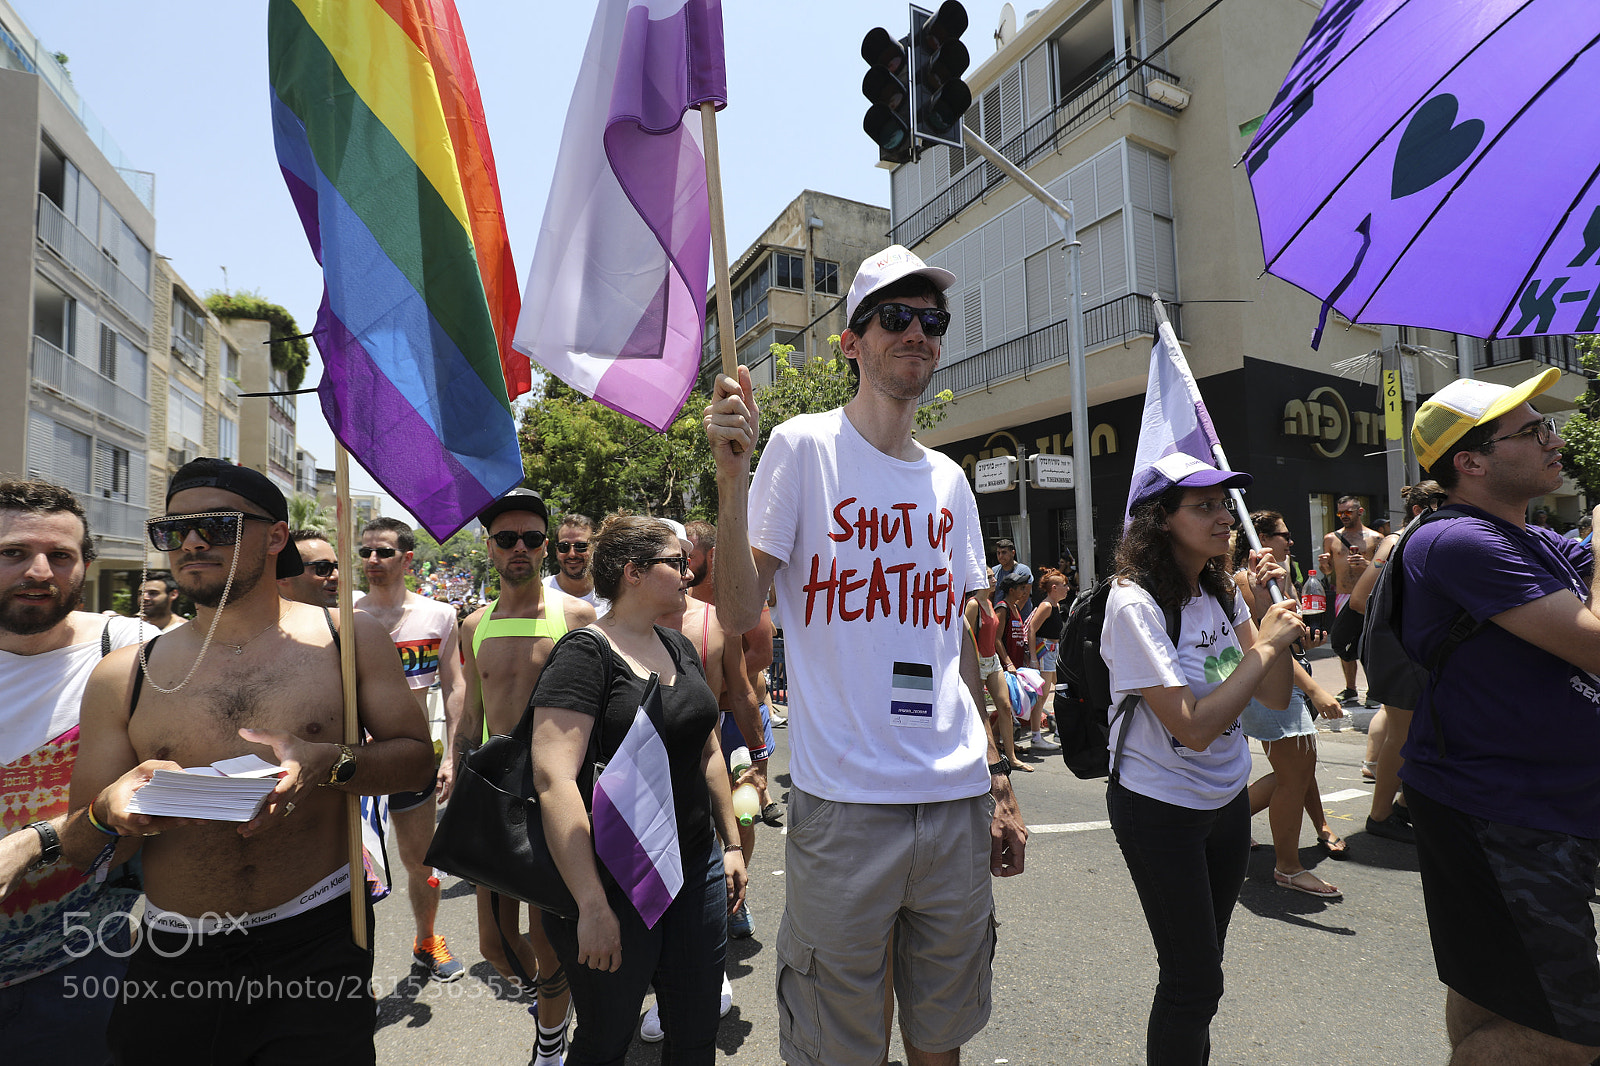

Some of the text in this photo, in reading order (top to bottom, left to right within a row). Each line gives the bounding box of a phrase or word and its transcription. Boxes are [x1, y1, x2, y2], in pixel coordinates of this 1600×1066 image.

[1387, 372, 1397, 412] 561
[827, 497, 918, 551] SHUT
[299, 872, 349, 905] Calvin Klein
[168, 918, 192, 929] Klein
[251, 912, 277, 924] Klein
